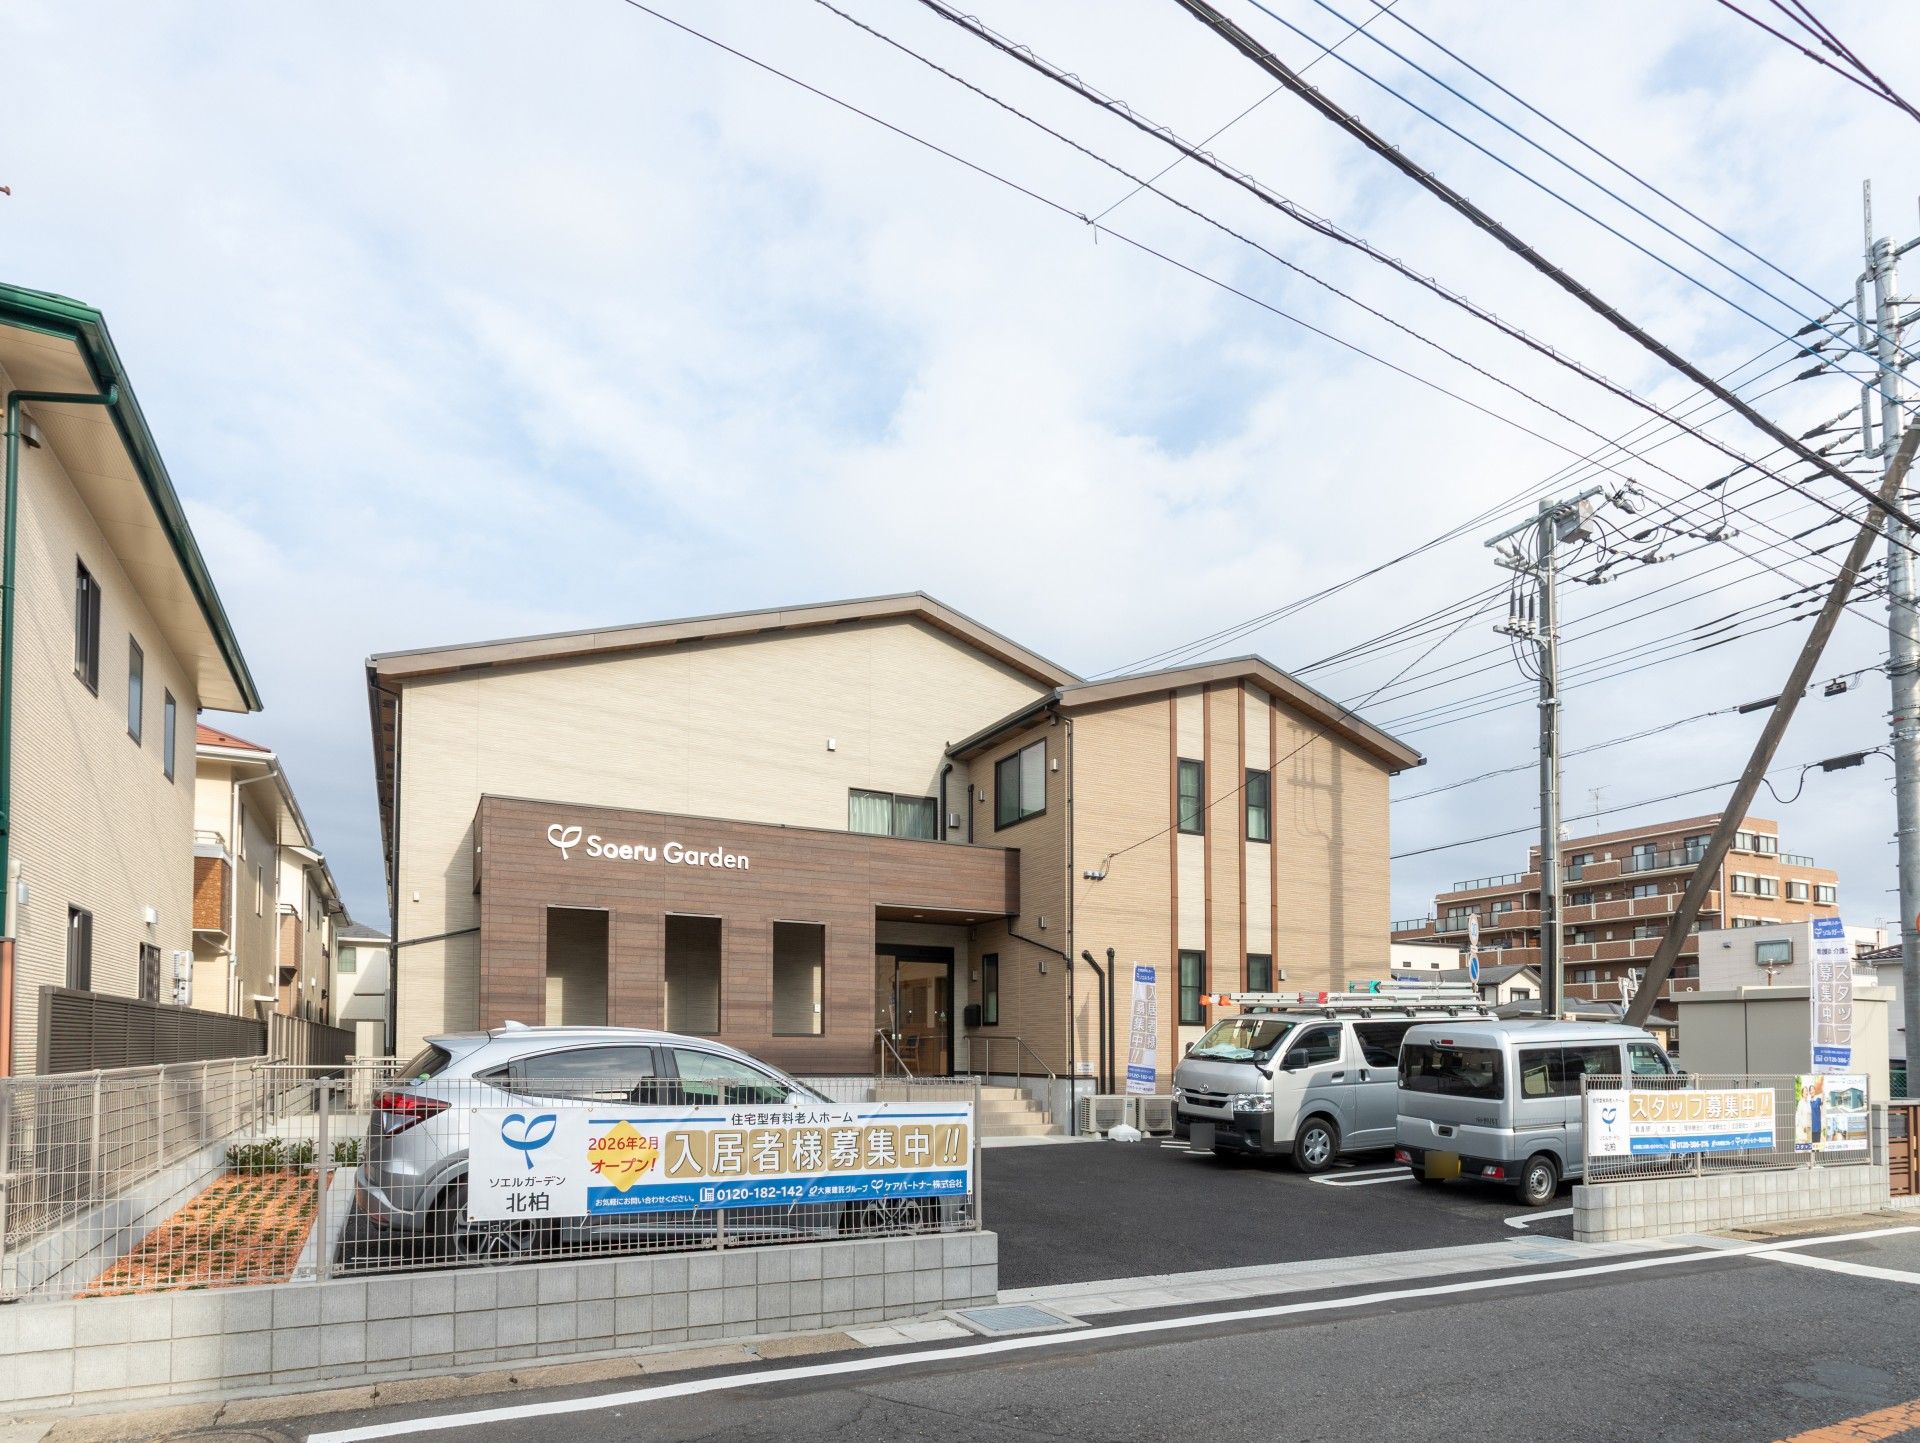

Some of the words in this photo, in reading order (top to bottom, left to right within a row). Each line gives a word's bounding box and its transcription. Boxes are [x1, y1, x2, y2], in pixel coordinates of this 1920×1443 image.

[586, 835, 657, 862] Soeru
[663, 841, 749, 870] Garden
[1836, 964, 1851, 1044] スタッフ
[731, 1112, 853, 1125] 住宅型有料老人ホーム
[588, 1136, 660, 1151] 2026年2月
[669, 1127, 962, 1174] 入居者様募集中!!
[590, 1156, 658, 1174] オープン!
[489, 1176, 566, 1188] ソエルガーデン
[506, 1191, 550, 1213] 北柏
[717, 1185, 804, 1201] 0120-182-142
